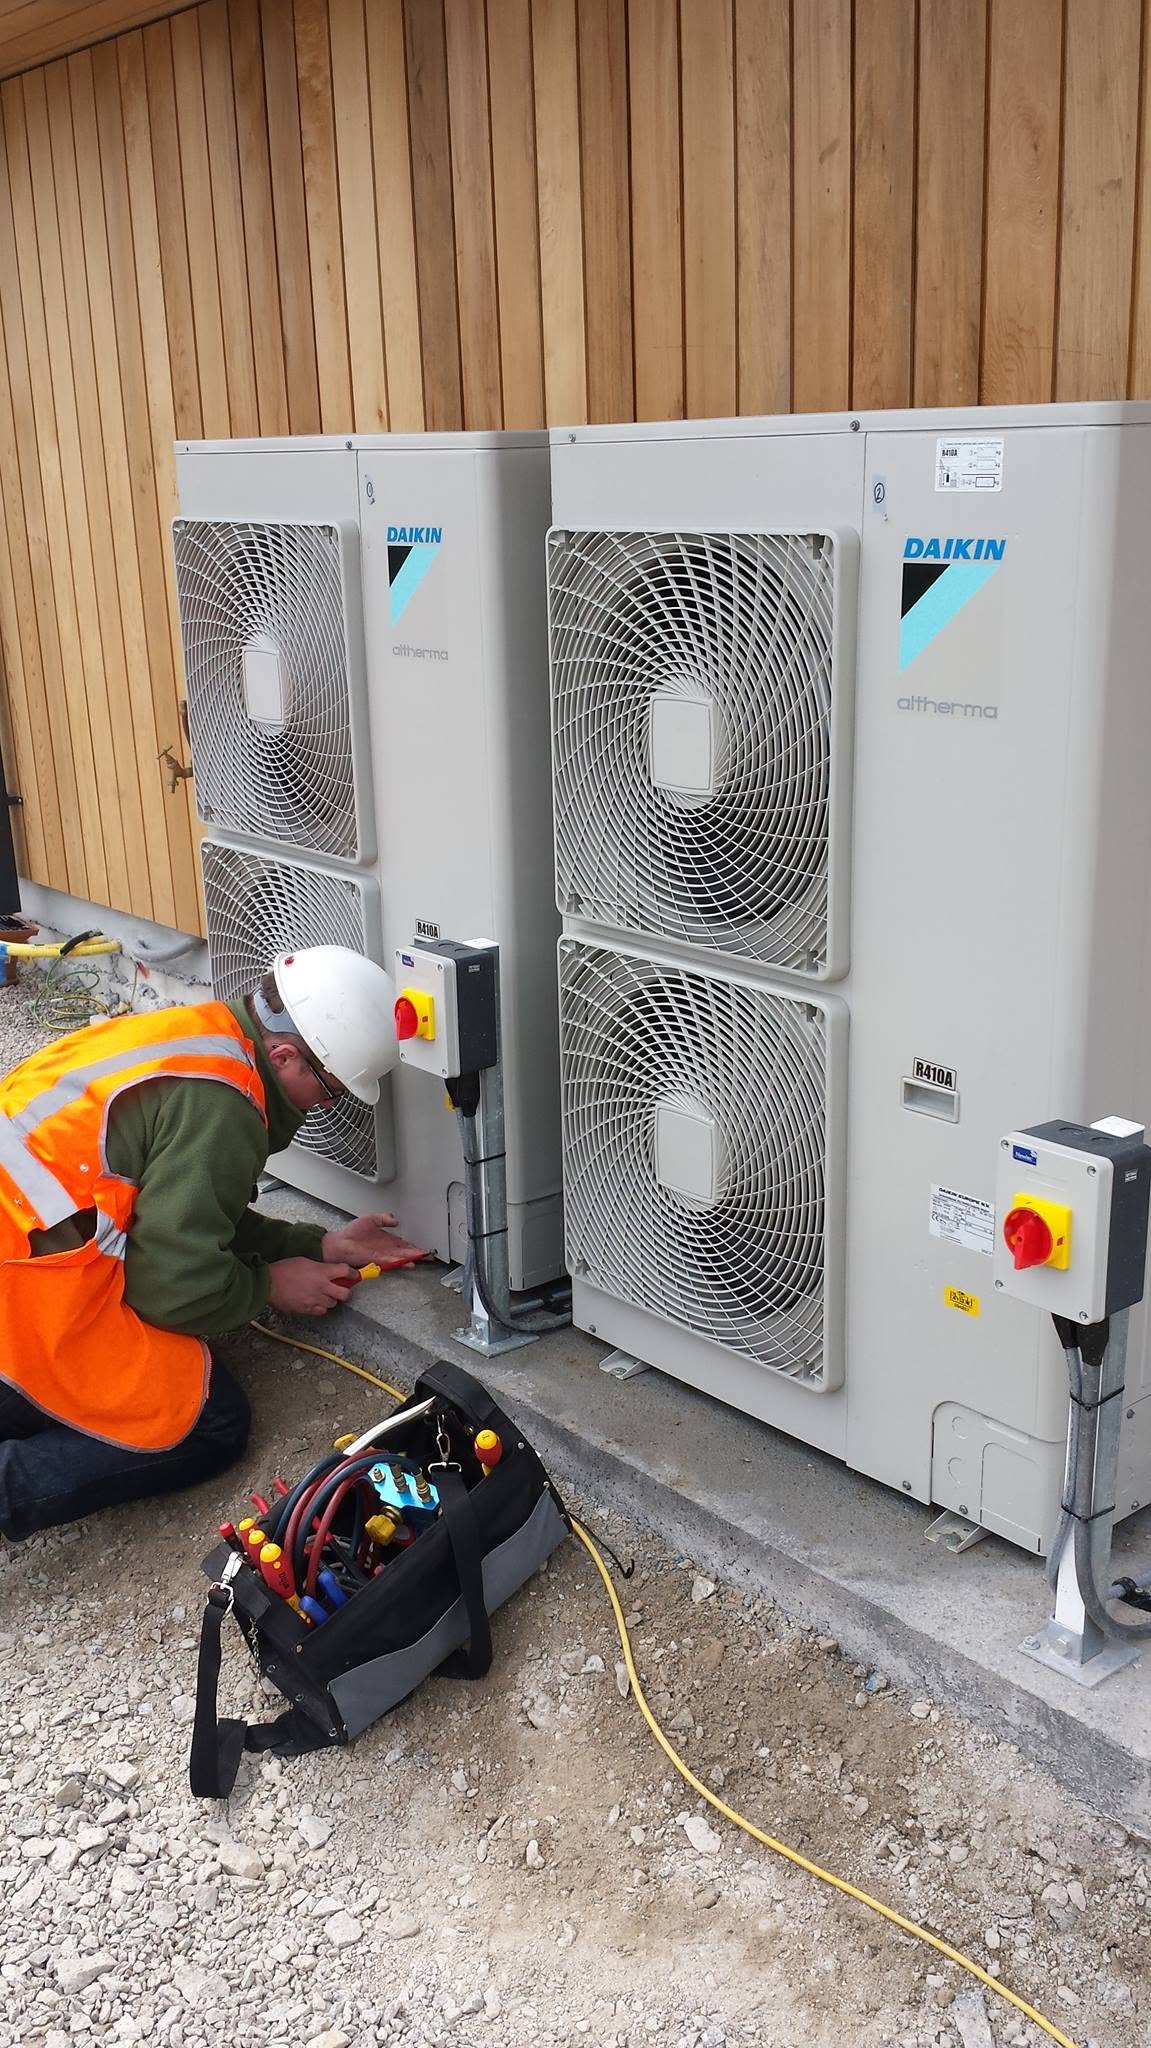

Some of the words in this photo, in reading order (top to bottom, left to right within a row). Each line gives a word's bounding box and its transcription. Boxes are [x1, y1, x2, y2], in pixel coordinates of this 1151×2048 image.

[387, 527, 442, 544] DAIKIN
[903, 538, 1006, 561] DAIKIN
[392, 643, 449, 661] altherma
[897, 695, 999, 720] altherma
[417, 921, 439, 938] R410A
[915, 1060, 953, 1088] R410A
